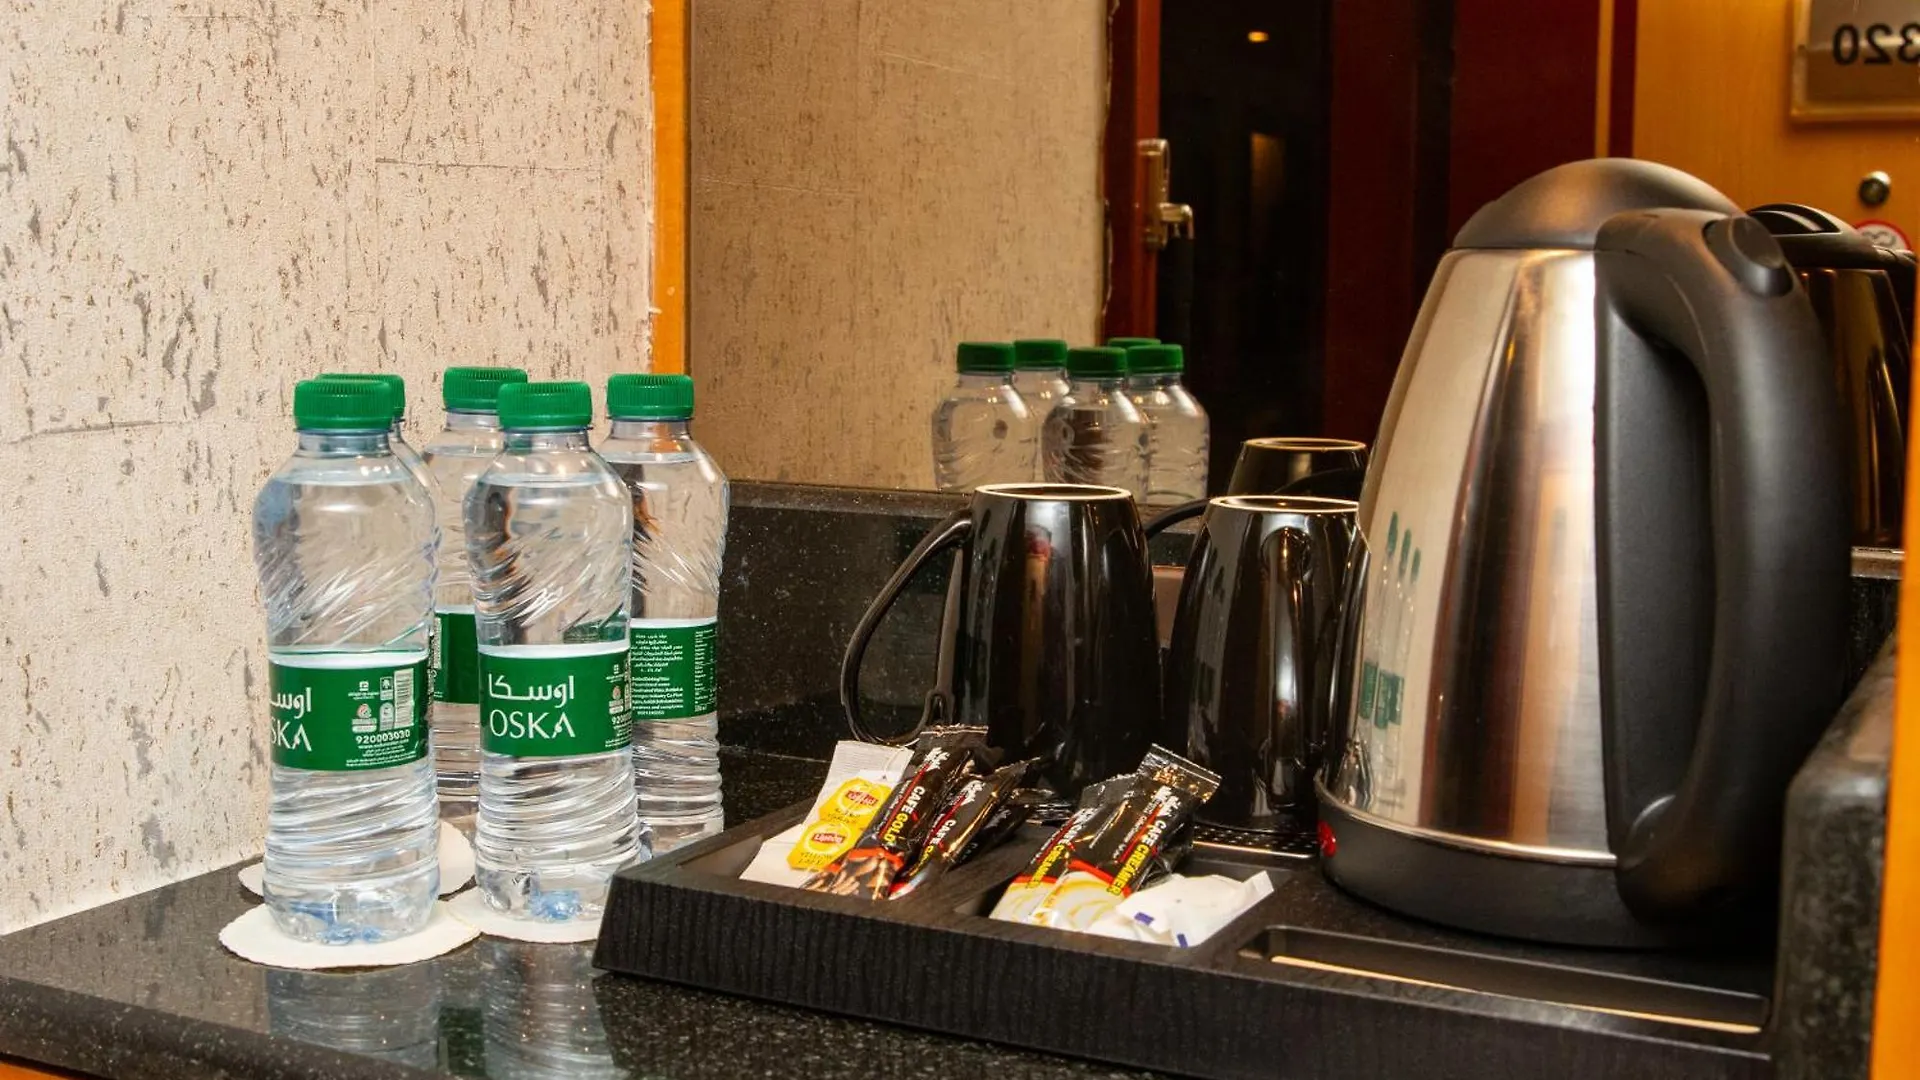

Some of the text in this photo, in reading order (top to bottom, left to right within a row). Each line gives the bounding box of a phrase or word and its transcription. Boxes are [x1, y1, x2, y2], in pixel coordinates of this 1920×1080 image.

[488, 672, 575, 709] اوسكا
[355, 729, 411, 745] 920003030
[489, 708, 577, 740] OSKA
[901, 785, 926, 814] CAFE
